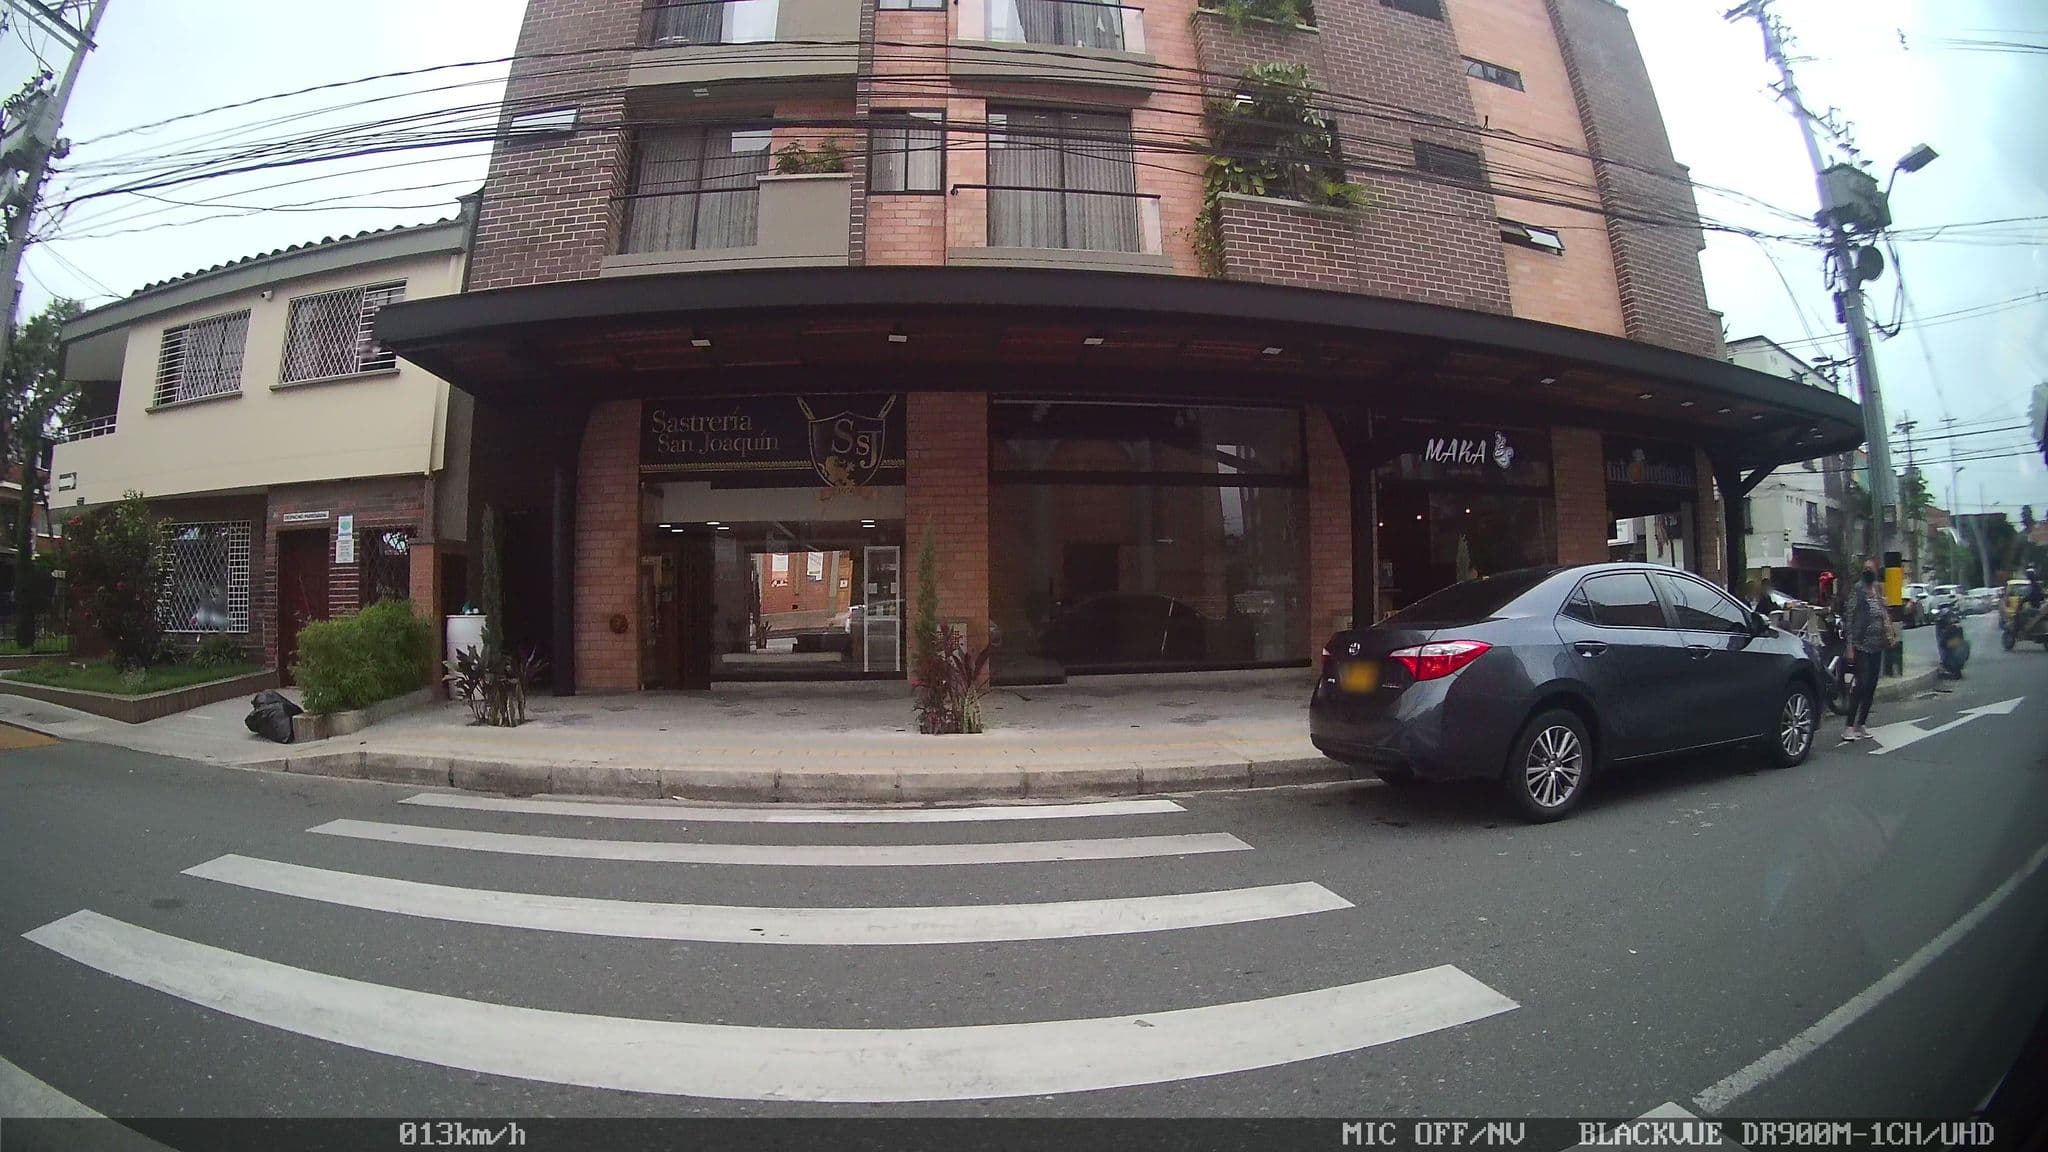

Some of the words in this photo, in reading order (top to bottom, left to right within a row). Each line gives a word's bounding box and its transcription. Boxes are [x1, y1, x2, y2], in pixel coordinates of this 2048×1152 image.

[652, 407, 752, 434] Sastrería
[658, 433, 694, 454] San
[699, 430, 779, 457] Joaquín
[1425, 438, 1487, 464] MAKA
